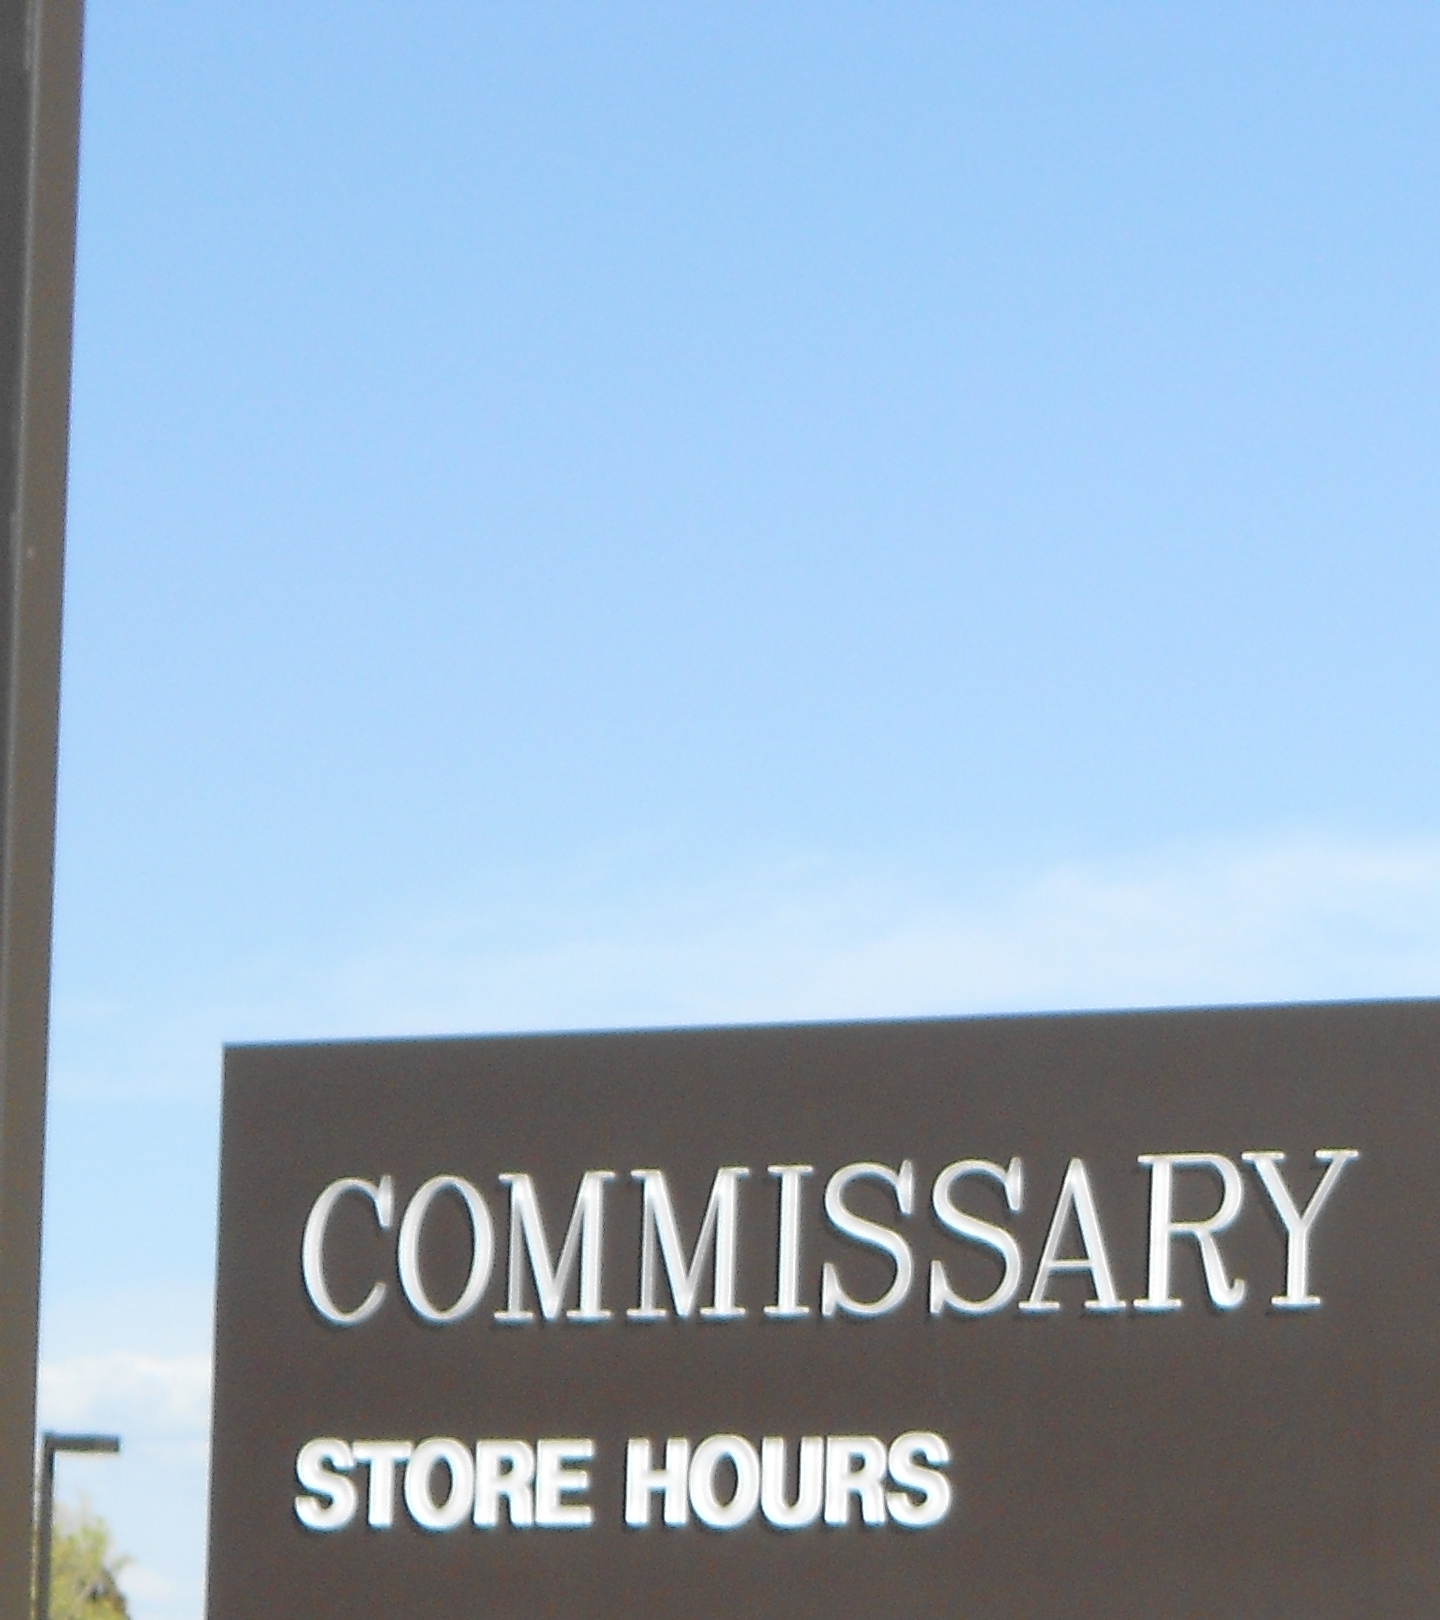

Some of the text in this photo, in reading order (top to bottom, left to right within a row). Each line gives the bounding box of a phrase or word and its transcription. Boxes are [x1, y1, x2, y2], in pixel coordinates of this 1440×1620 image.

[302, 1148, 1360, 1324] COMMISSARY
[294, 1431, 954, 1531] STORE HOURS
